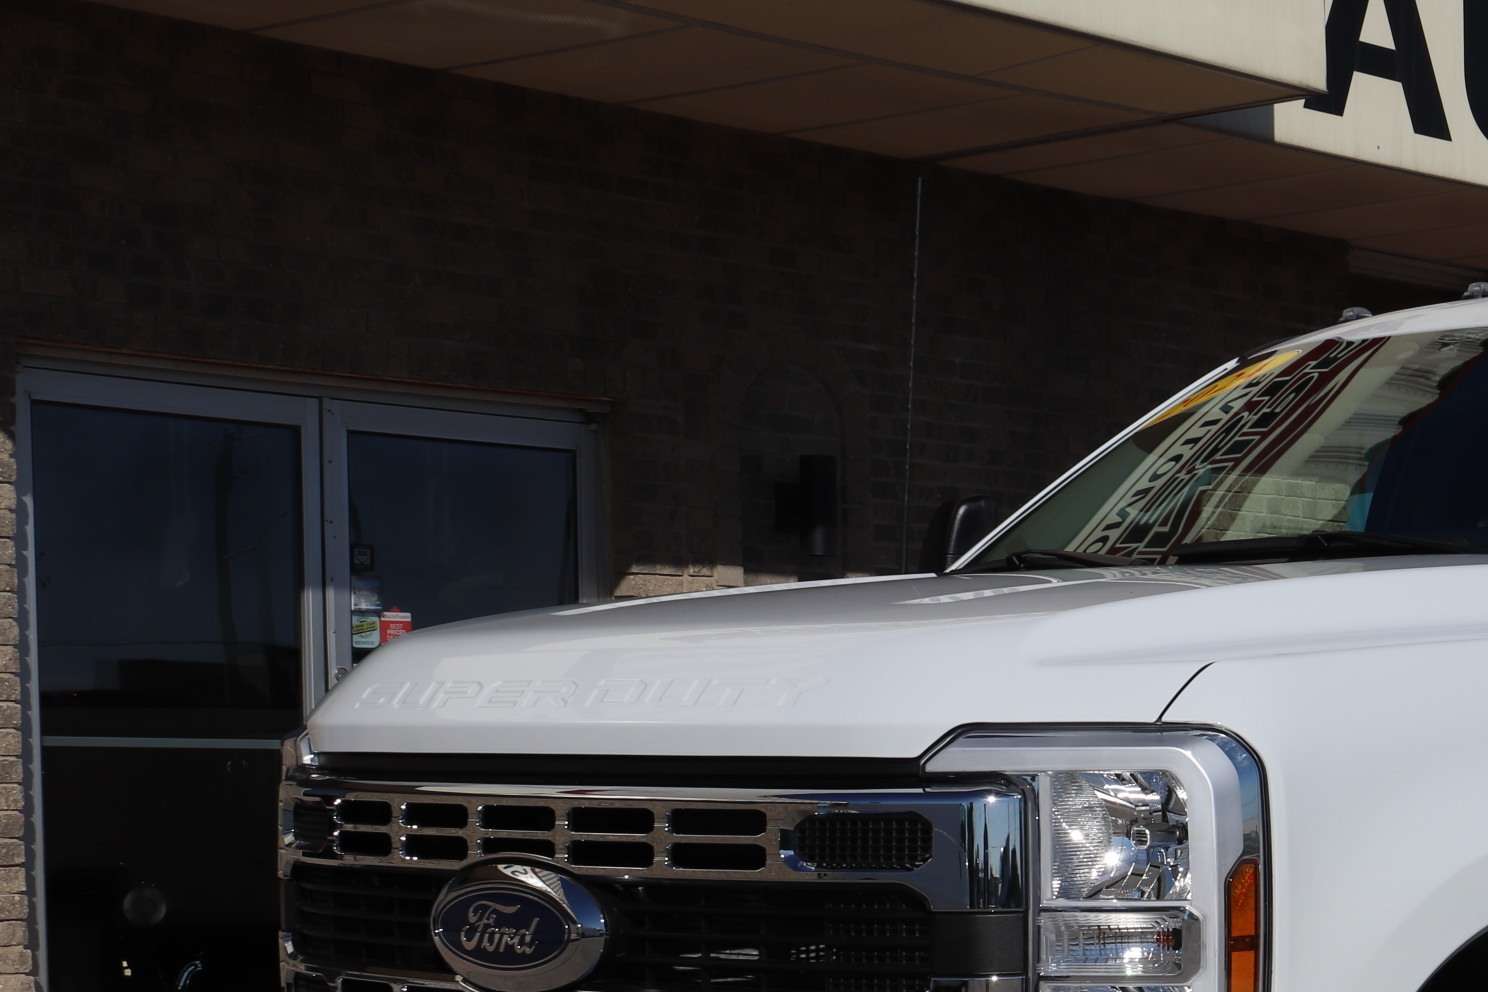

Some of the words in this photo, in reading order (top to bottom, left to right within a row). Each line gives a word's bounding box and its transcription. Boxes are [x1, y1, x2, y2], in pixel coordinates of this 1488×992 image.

[353, 679, 578, 711] SUPER
[584, 676, 832, 711] DUTY
[460, 900, 541, 955] Ford
